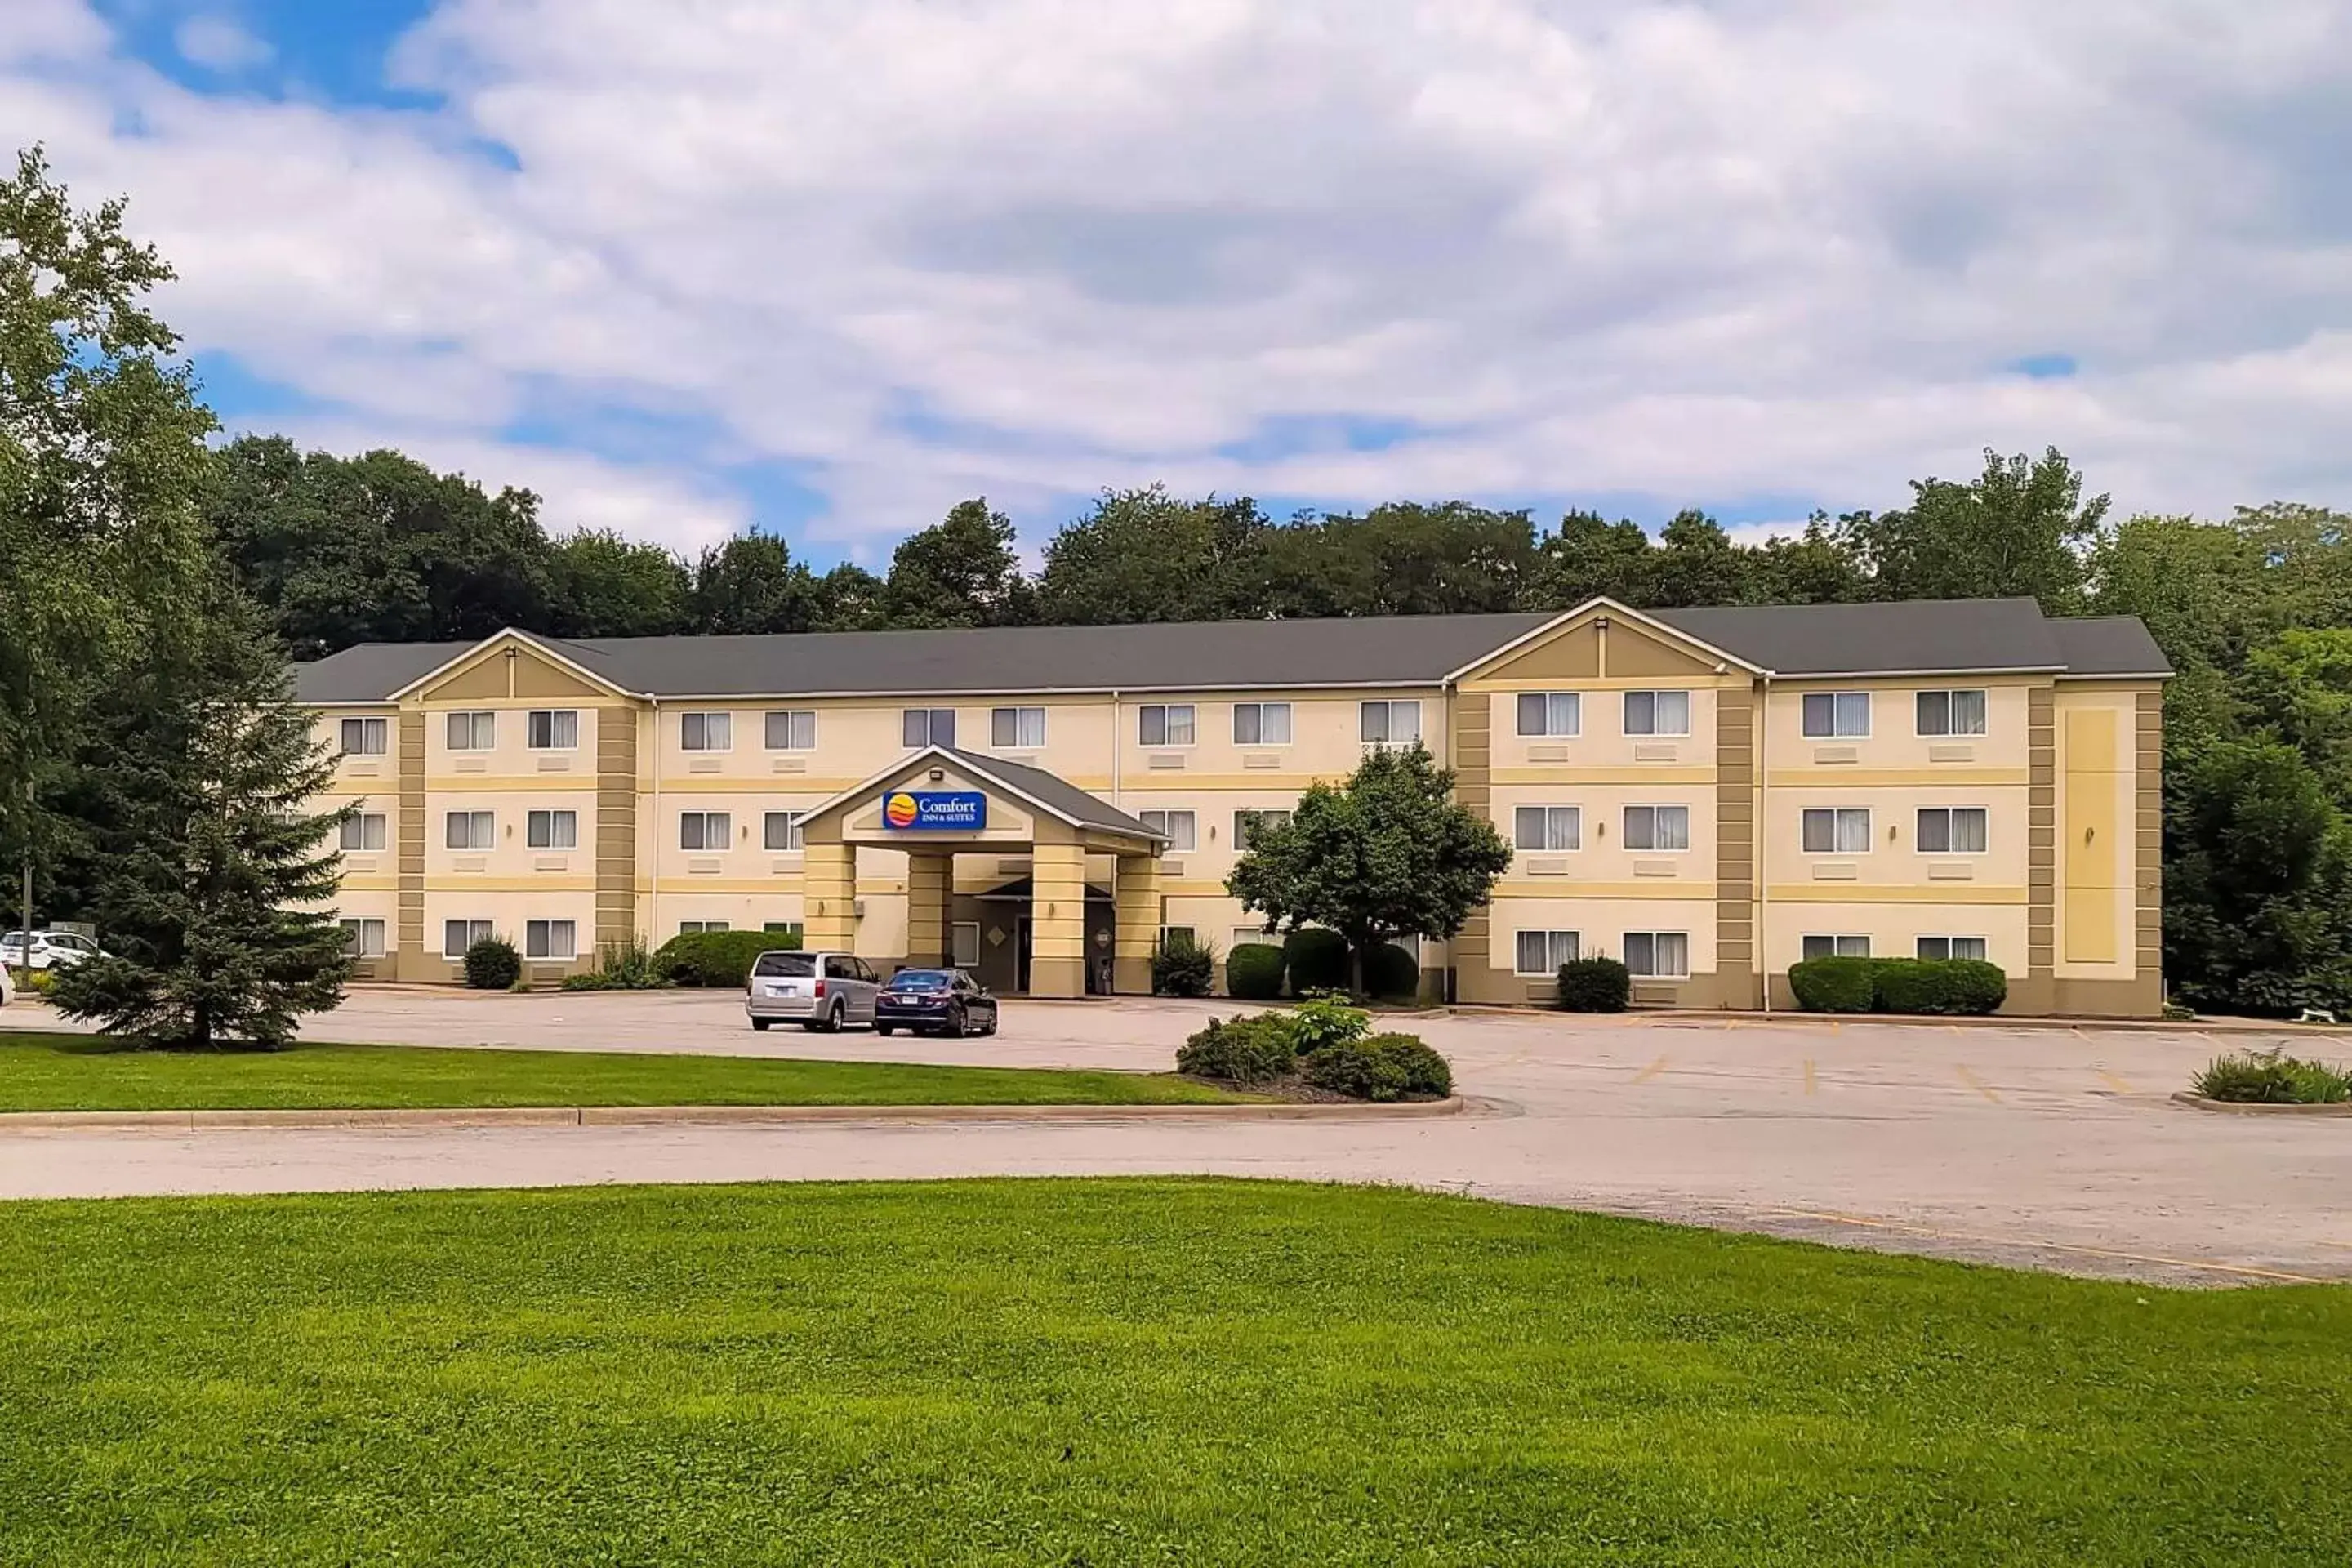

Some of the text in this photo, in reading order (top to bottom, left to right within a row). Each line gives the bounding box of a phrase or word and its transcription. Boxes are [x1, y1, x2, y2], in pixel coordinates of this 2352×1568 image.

[919, 798, 976, 813] Comfort
[922, 813, 974, 822] INN & SUITES
